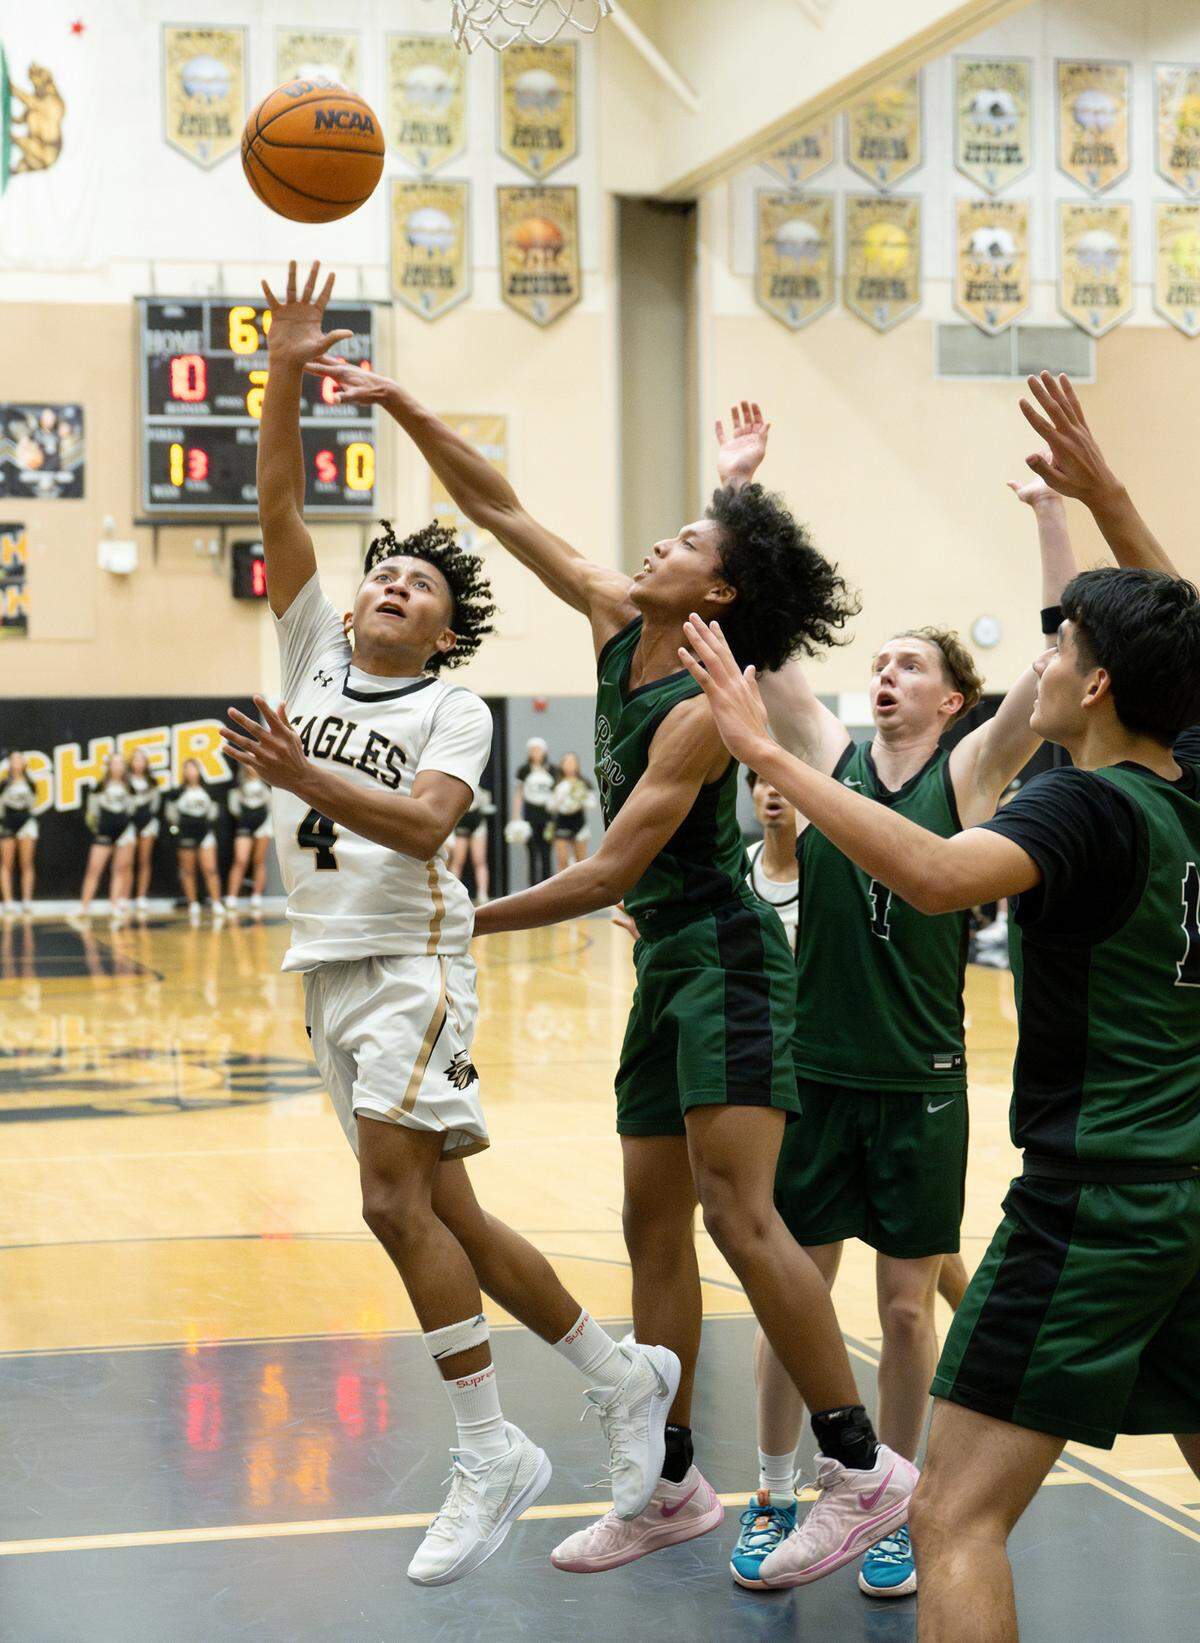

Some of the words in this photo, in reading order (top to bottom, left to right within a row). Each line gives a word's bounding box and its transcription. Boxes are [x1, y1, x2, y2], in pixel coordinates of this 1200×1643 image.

[314, 109, 375, 135] NCAA
[147, 329, 201, 353] HOME
[170, 354, 207, 403] 0
[169, 443, 184, 487] 1
[188, 447, 209, 481] 3
[315, 450, 338, 483] 5
[346, 442, 375, 490] 0
[297, 808, 340, 873] 4
